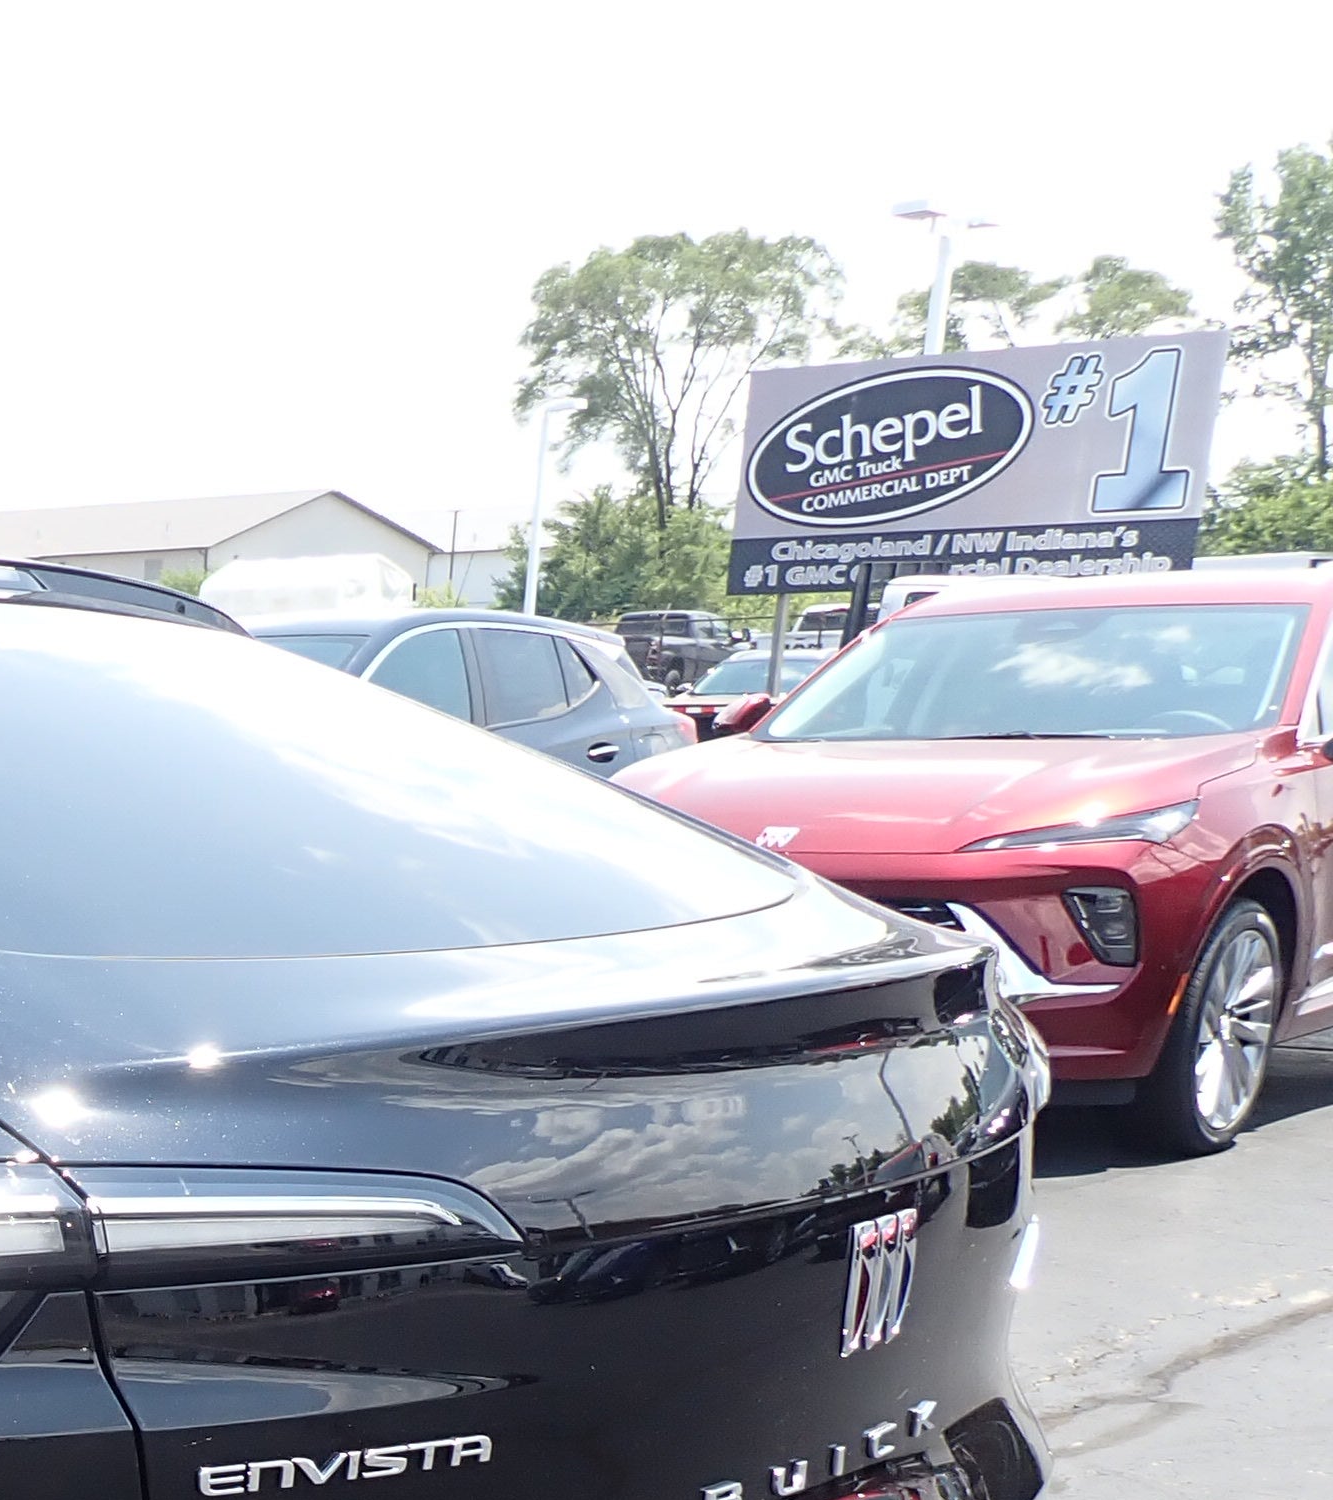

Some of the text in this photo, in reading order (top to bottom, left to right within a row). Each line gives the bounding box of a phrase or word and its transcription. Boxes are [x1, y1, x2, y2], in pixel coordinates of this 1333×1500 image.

[784, 384, 984, 473] Schepel
[1042, 346, 1191, 516] #1
[801, 464, 973, 513] COMMERCIAL DEPT
[809, 455, 903, 488] GMC Truck
[743, 564, 779, 588] #1
[784, 564, 847, 586] GMC
[1014, 551, 1173, 578] Dealership
[771, 533, 933, 564] Chicagoland
[951, 531, 1003, 555] NW
[1005, 526, 1140, 552] Indiana's
[198, 1433, 493, 1497] ENVISTA
